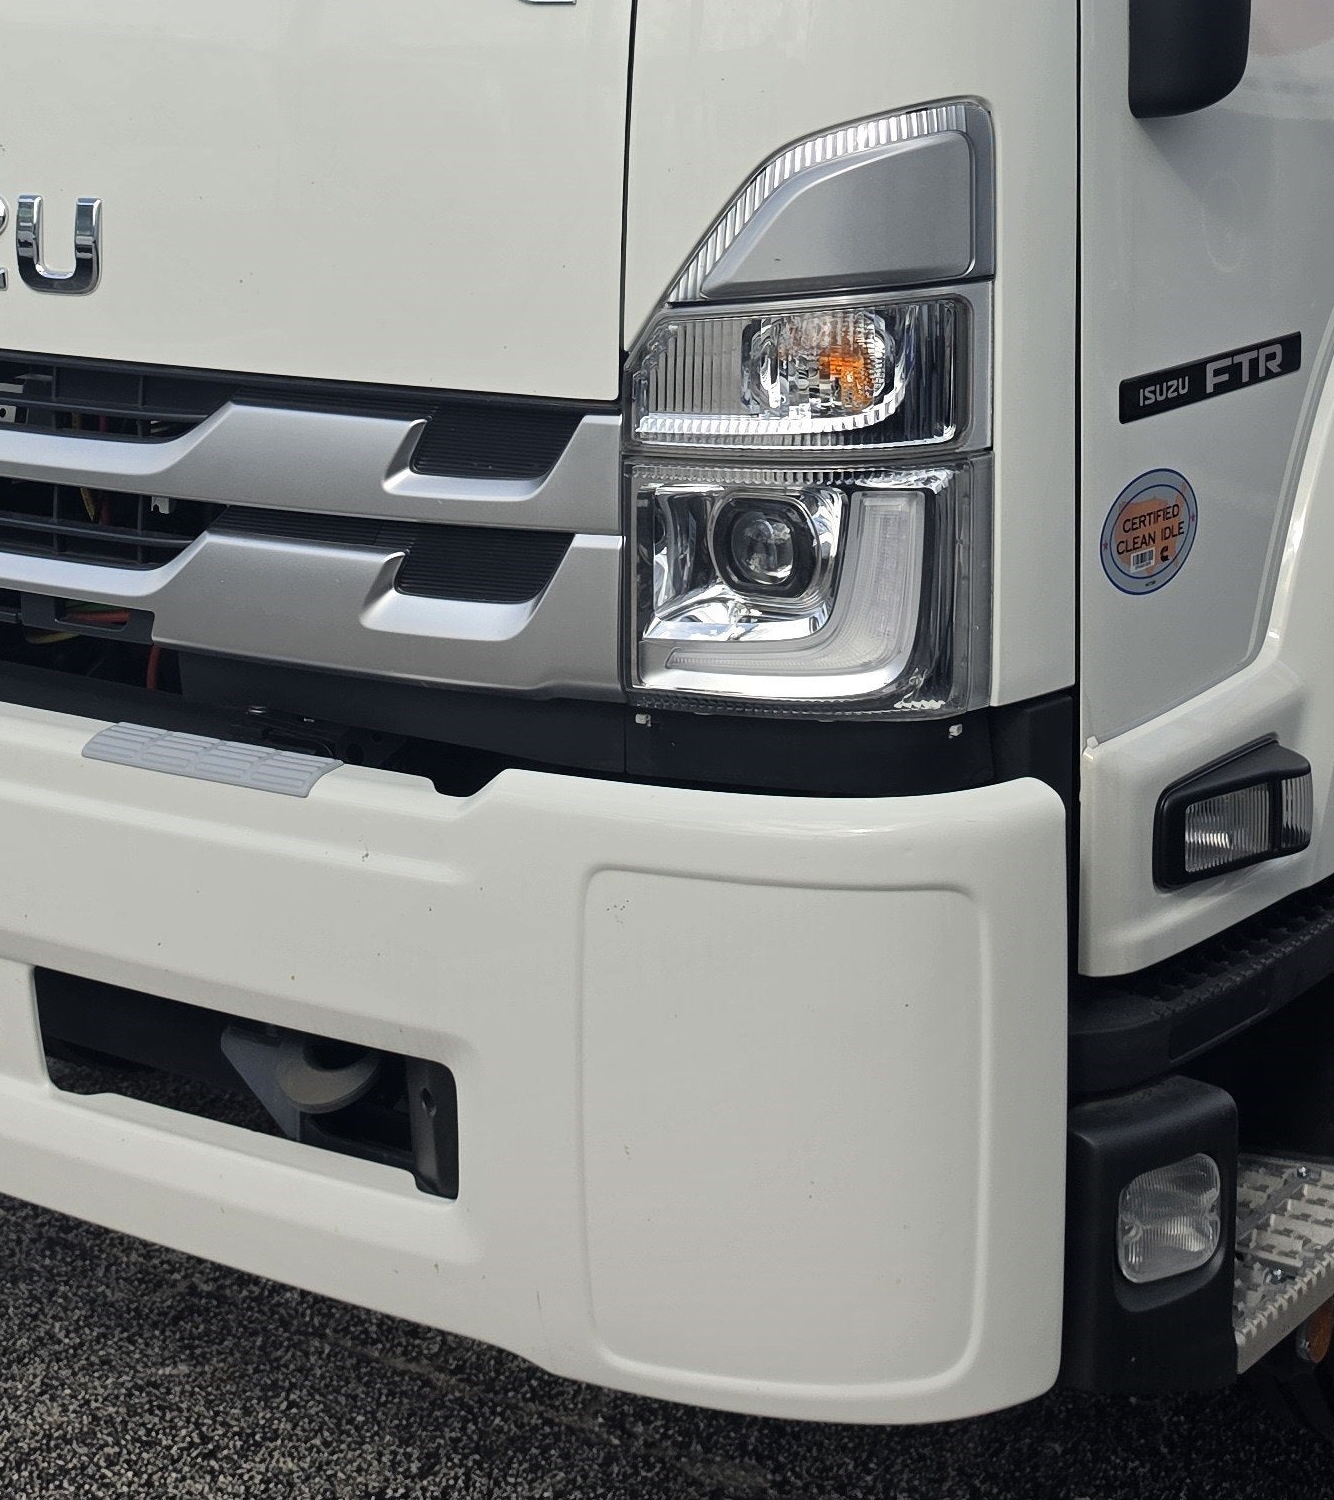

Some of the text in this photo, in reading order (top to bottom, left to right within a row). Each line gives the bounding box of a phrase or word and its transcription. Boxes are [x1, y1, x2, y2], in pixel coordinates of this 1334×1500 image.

[1139, 343, 1283, 407] ISUZU FTR
[1122, 503, 1180, 534] CERTIFIED
[1116, 520, 1185, 556] CLEAN IDLE
